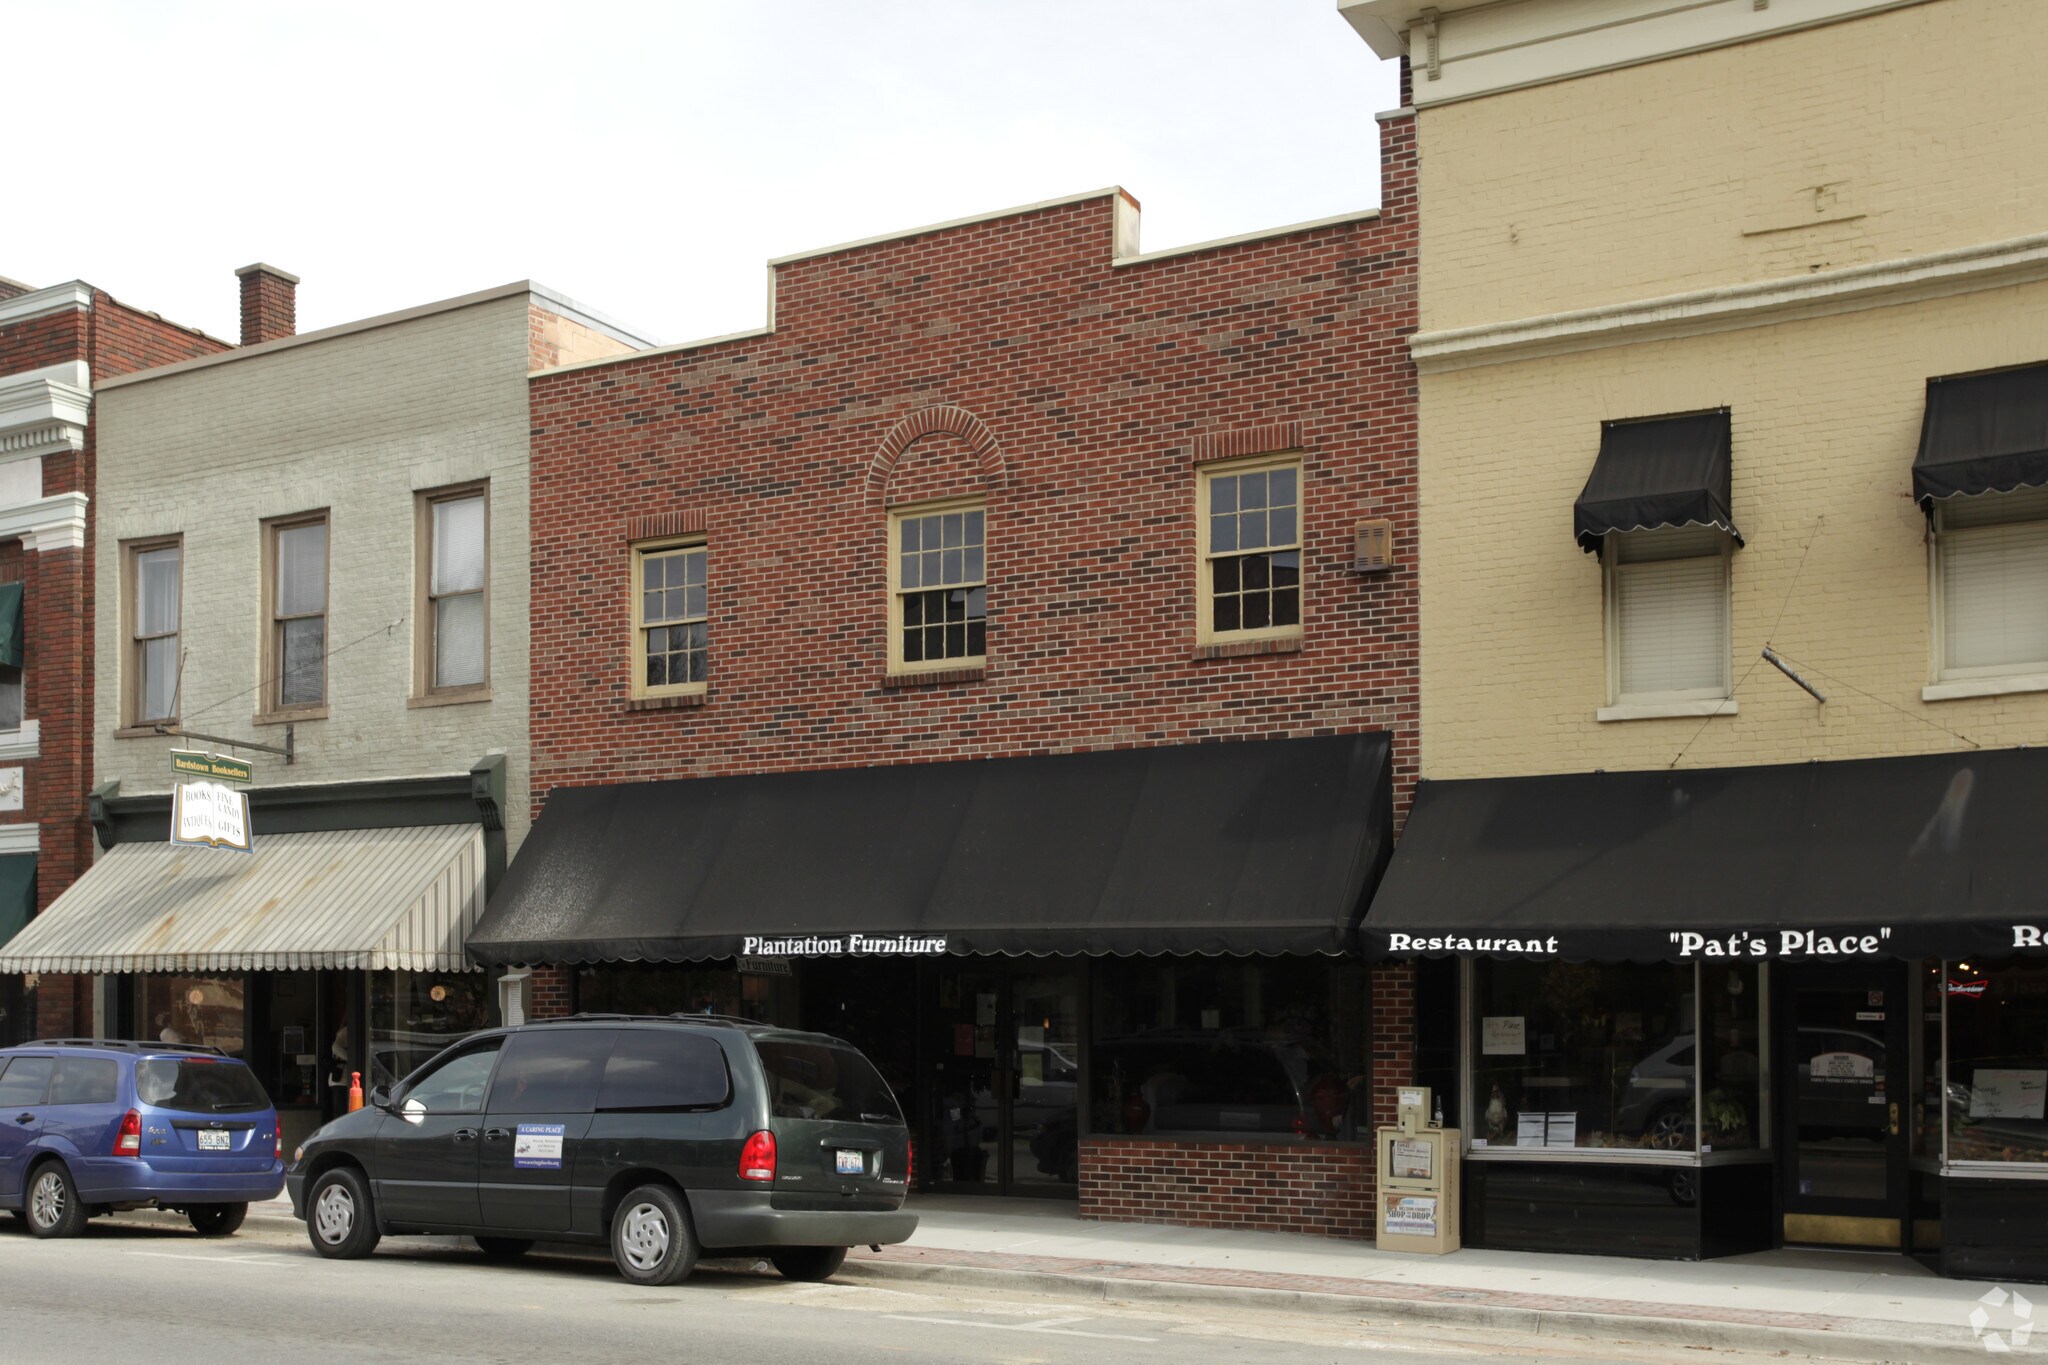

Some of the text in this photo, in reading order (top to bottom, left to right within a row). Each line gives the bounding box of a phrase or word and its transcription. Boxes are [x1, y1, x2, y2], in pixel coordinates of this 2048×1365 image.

[175, 758, 248, 778] Bardstown Booksellers
[185, 789, 212, 803] BOOKS
[217, 791, 232, 806] FINE
[218, 804, 240, 820] CANDY
[183, 814, 213, 829] ANTIQUES
[218, 820, 241, 838] GIFTS
[743, 934, 946, 955] Plantation Furniture
[1388, 933, 1559, 953] Restaurant
[1669, 927, 1891, 956] "Pat's Place"
[746, 958, 789, 973] Furniture
[199, 1135, 213, 1144] 655
[1388, 1208, 1406, 1219] SHOP
[1411, 1210, 1431, 1220] DROP
